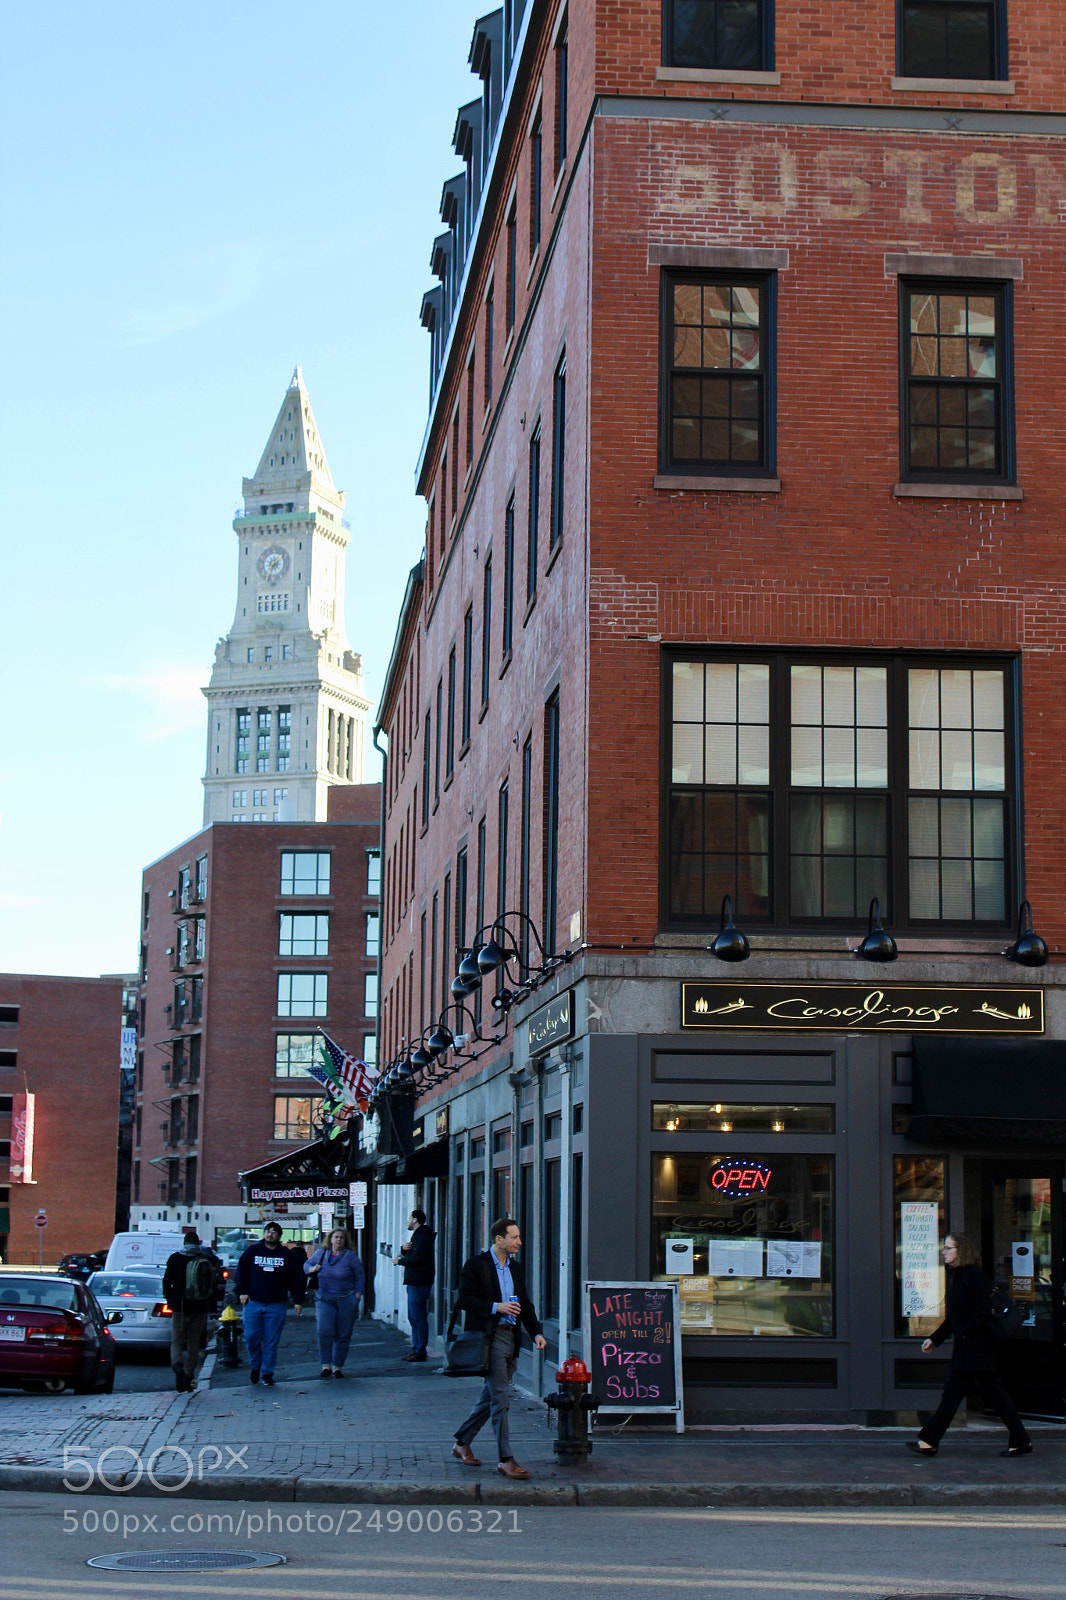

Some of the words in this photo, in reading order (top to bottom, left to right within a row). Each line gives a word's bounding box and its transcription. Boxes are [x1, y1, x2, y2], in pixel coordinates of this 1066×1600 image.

[767, 990, 959, 1025] Casalinga
[711, 1169, 772, 1189] OPEN
[251, 1187, 314, 1200] Haymarket
[317, 1186, 349, 1197] Pizza
[908, 1233, 927, 1241] PIZZA
[254, 1256, 284, 1266] BRANDEIS
[908, 1262, 928, 1270] PASTA
[592, 1293, 632, 1317] LATE
[615, 1311, 664, 1328] NIGHT
[601, 1330, 626, 1339] OPEN
[631, 1329, 649, 1338] TILL
[601, 1343, 662, 1366] Pizza
[606, 1375, 660, 1398] Subs
